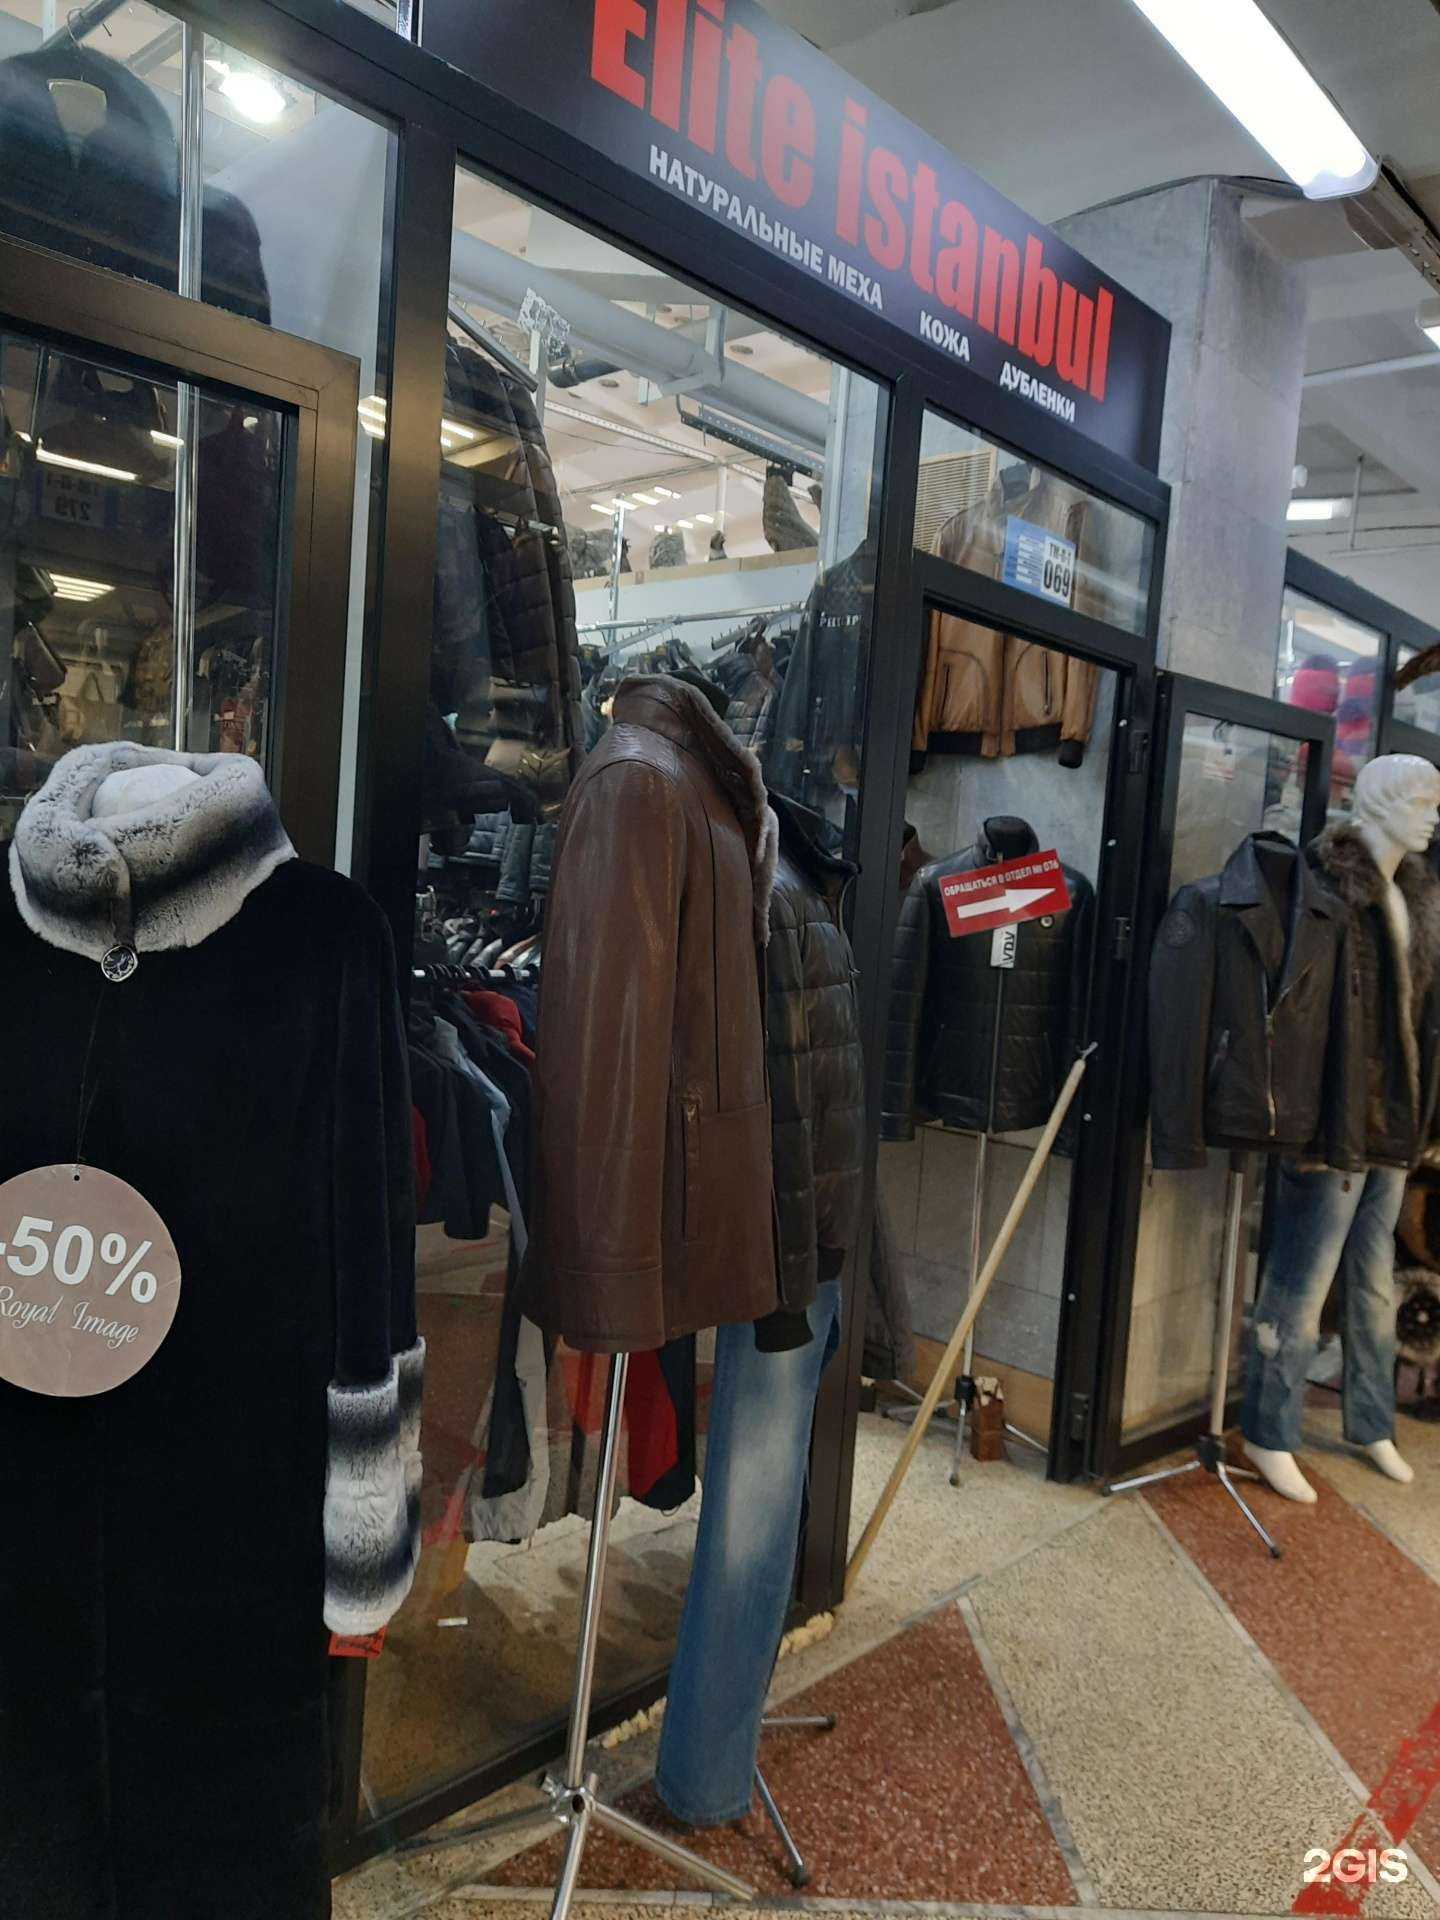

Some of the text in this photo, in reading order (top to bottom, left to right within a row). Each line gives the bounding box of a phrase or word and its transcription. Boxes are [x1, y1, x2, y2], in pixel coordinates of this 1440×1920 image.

[591, 0, 1114, 404] Elite istanbul
[650, 144, 884, 312] НАТУРАЛЬНЫЕ МЕХА
[920, 310, 970, 362] КОЖА
[1000, 360, 1076, 423] ДУБЛЕНКИ
[1043, 559, 1071, 598] 069
[944, 875, 998, 897] ОБРАЩАТЬСЯ
[1005, 866, 1032, 883] ОТДЕЛ
[72, 1301, 140, 1350] Image
